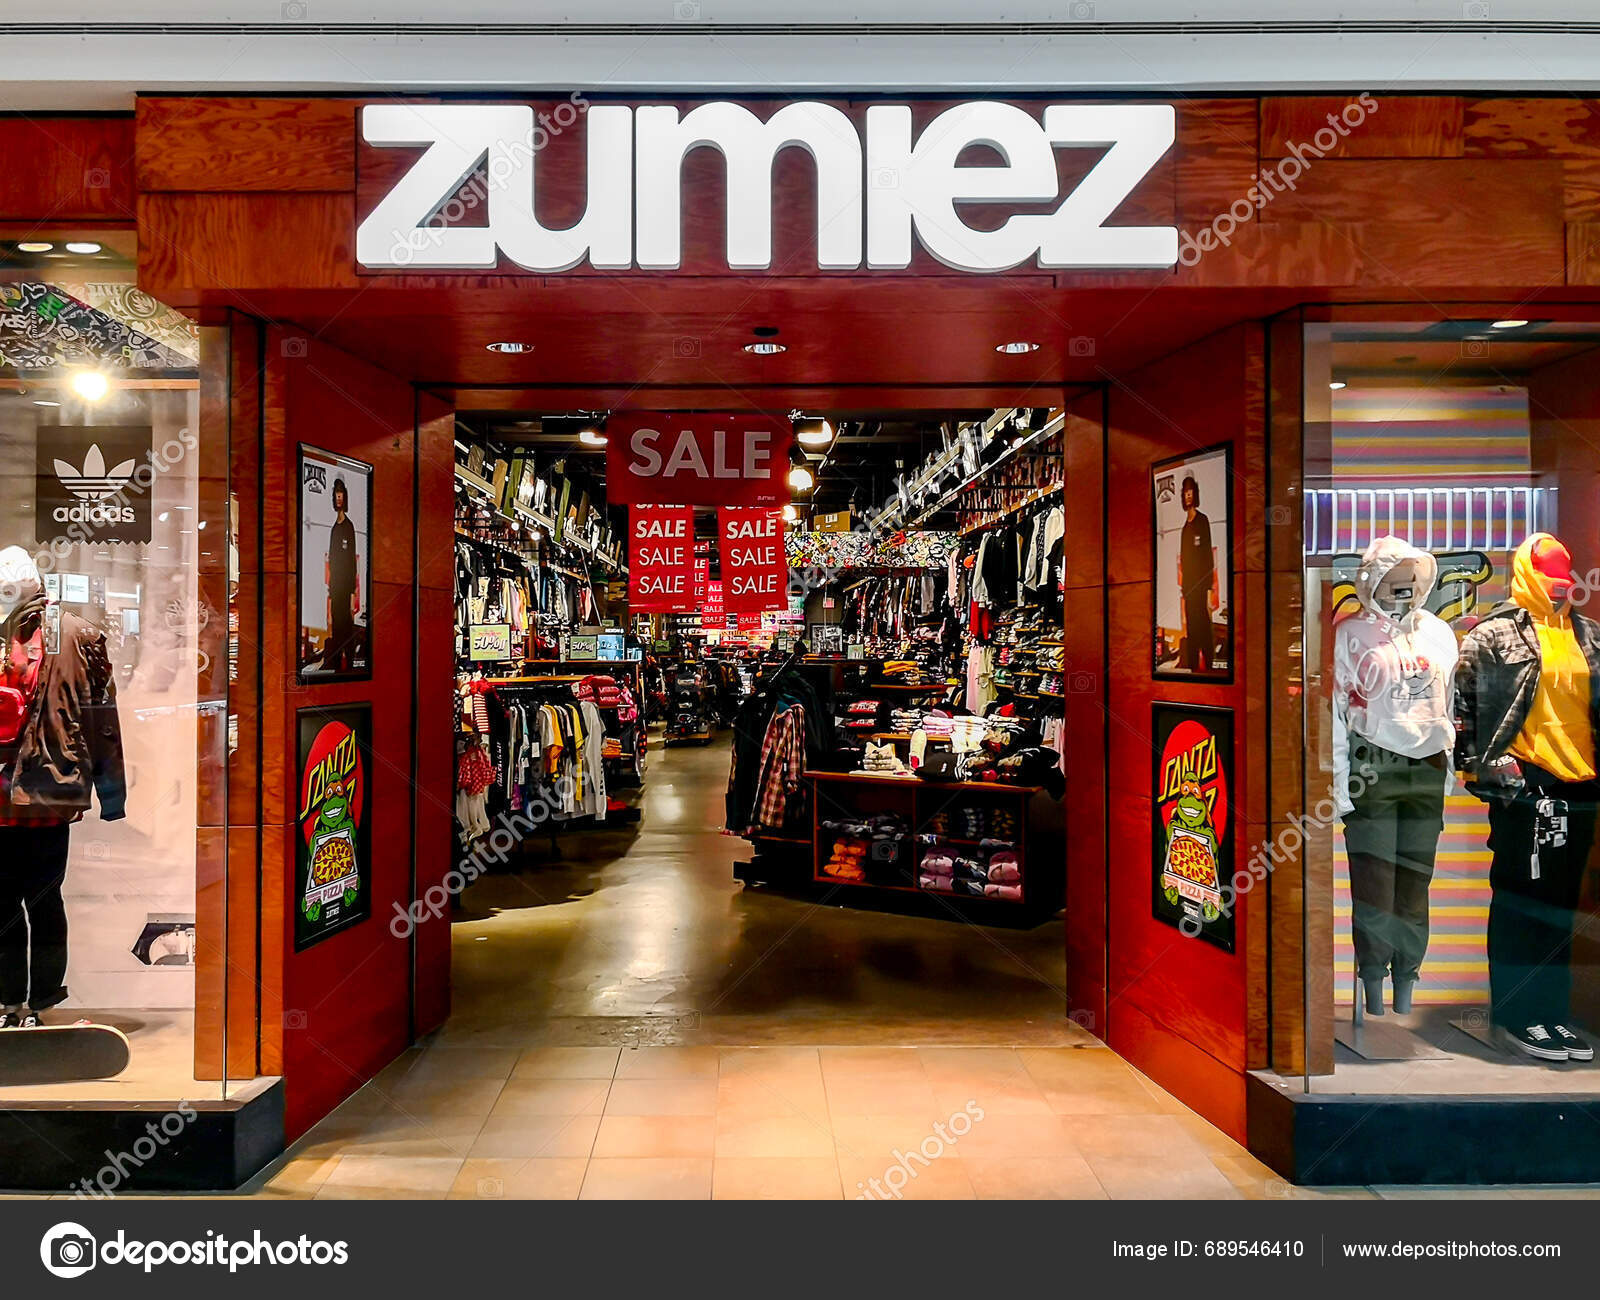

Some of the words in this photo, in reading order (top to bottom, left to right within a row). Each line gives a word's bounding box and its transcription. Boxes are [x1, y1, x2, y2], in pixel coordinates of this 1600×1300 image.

[357, 100, 1179, 273] zumiez
[628, 429, 771, 479] SALE
[53, 502, 136, 523] adidas
[635, 520, 687, 539] SALE
[726, 519, 777, 539] SALE
[638, 547, 684, 566] SALE
[694, 559, 706, 569] LE
[730, 547, 776, 567] SALE
[638, 575, 685, 594] SALE
[694, 572, 704, 582] LE
[731, 574, 778, 595] SALE
[694, 586, 704, 596] LE
[708, 584, 723, 592] ALE
[323, 883, 343, 901] PIZZA
